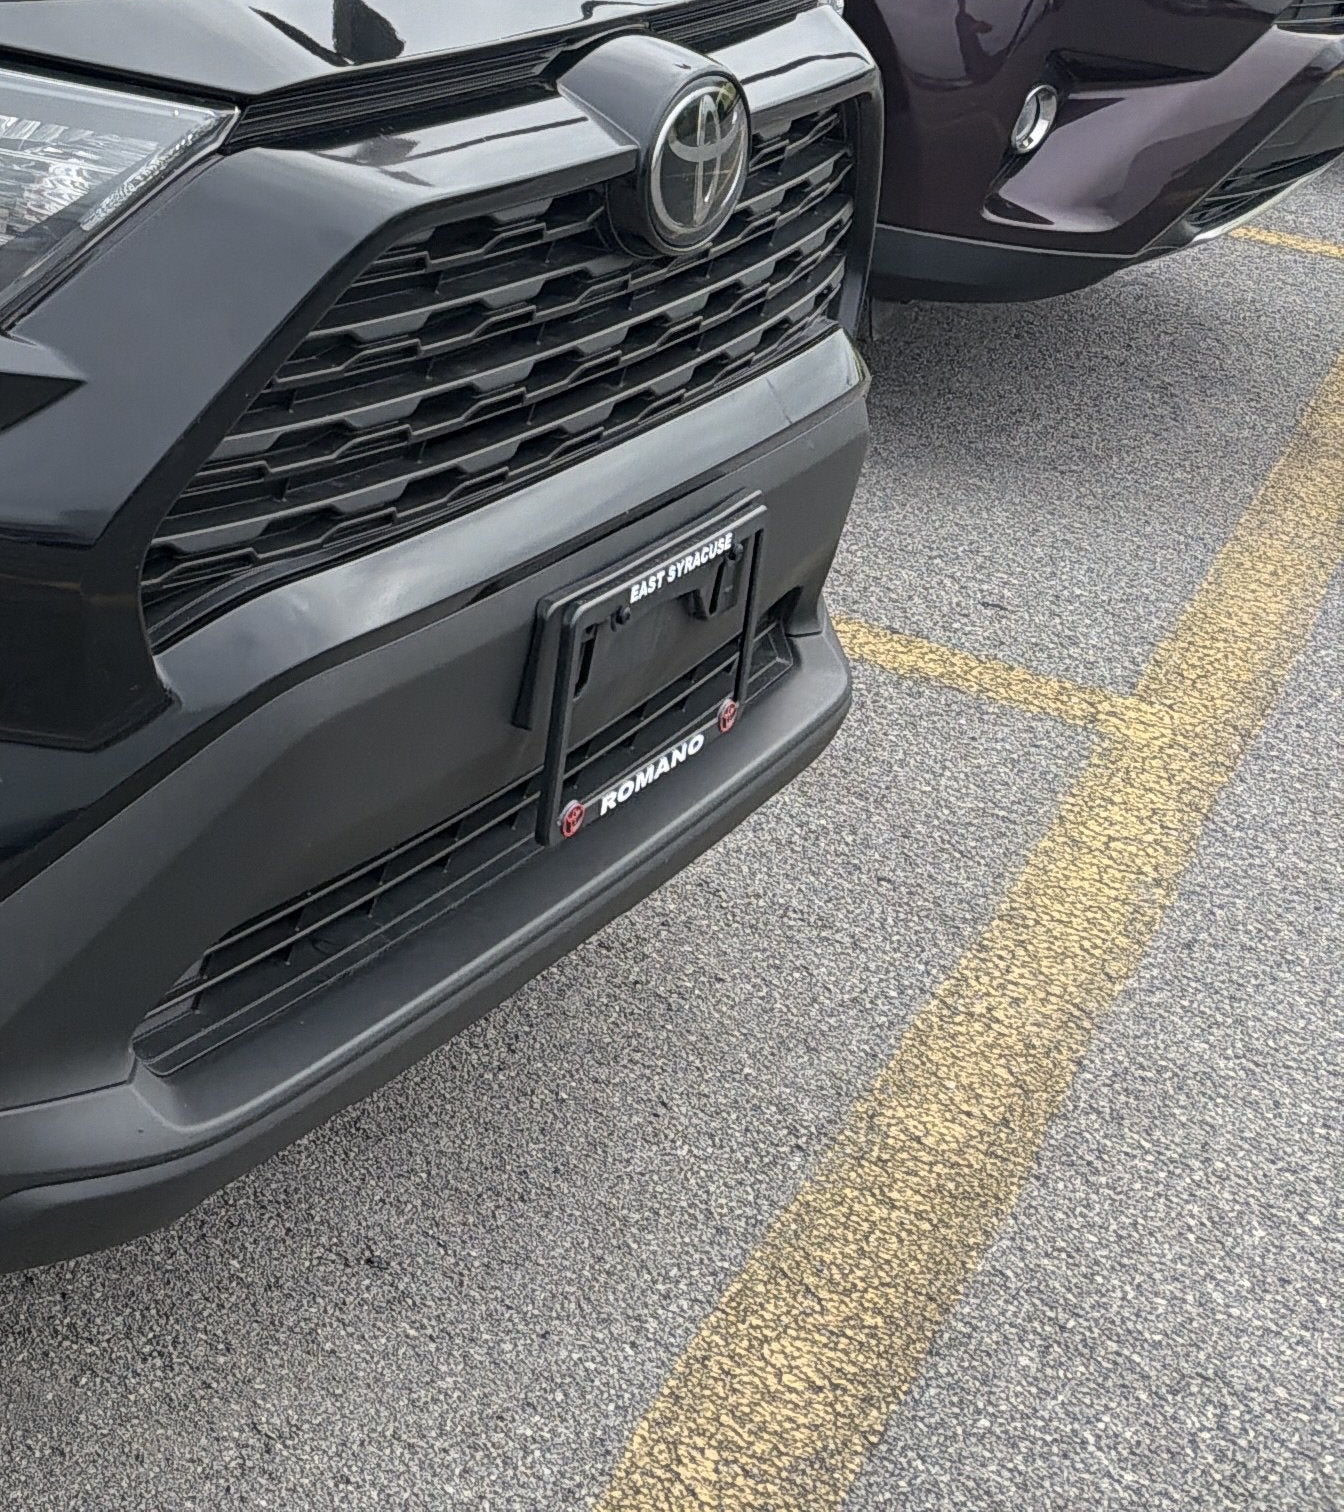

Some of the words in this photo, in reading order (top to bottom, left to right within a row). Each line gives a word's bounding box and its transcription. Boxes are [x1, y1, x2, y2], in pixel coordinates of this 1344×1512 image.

[629, 569, 666, 604] EAST
[667, 531, 734, 584] SYRACUSE
[599, 733, 705, 816] ROMANO
